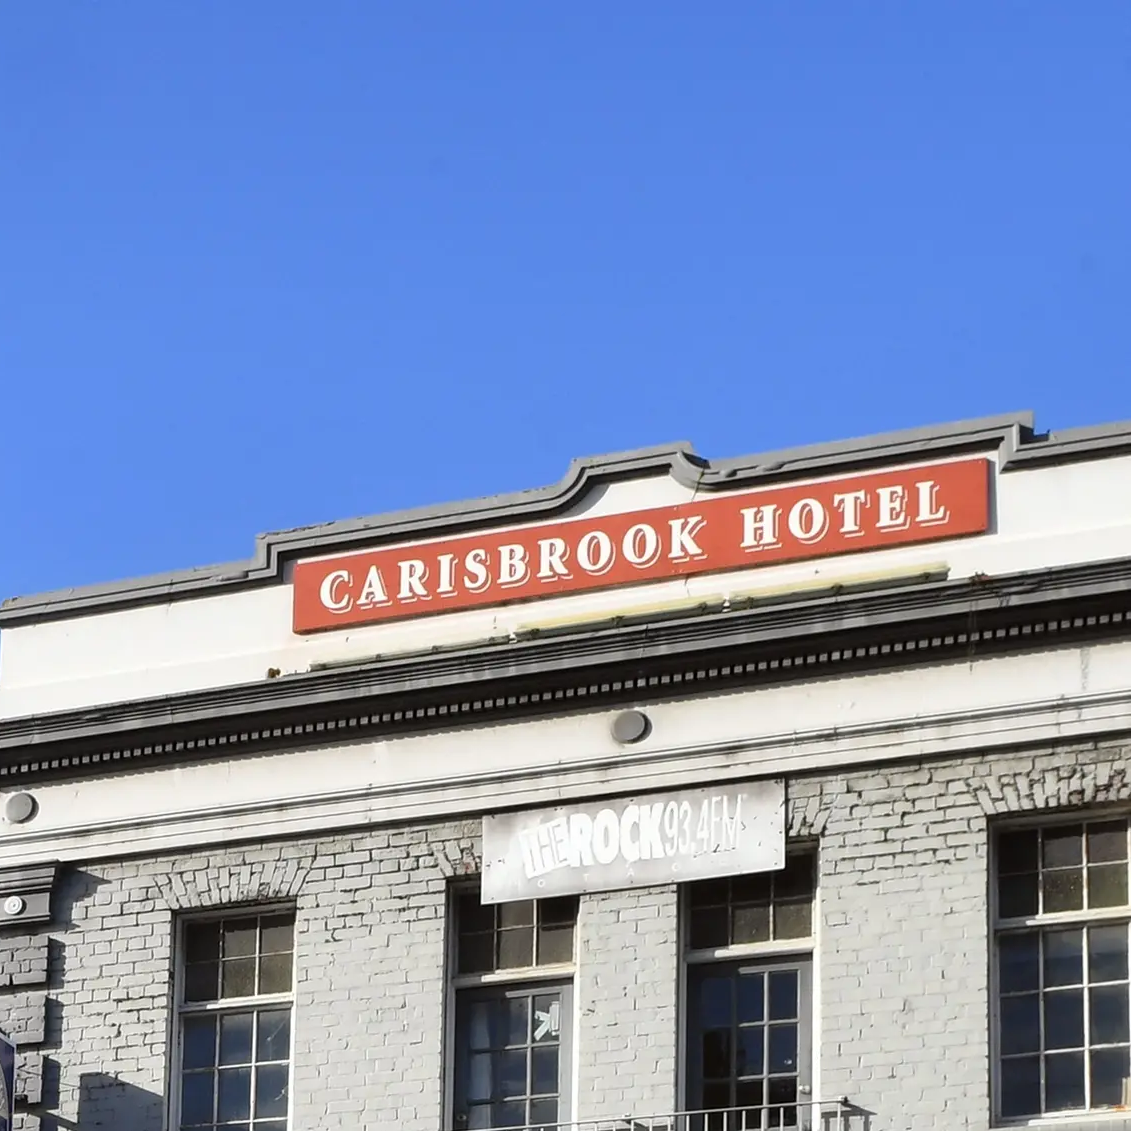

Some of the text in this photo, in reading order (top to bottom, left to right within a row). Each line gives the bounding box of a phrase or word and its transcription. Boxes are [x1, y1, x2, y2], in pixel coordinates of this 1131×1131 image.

[319, 480, 949, 614] CARISBROOK HOTEL
[568, 803, 666, 867] ROCK
